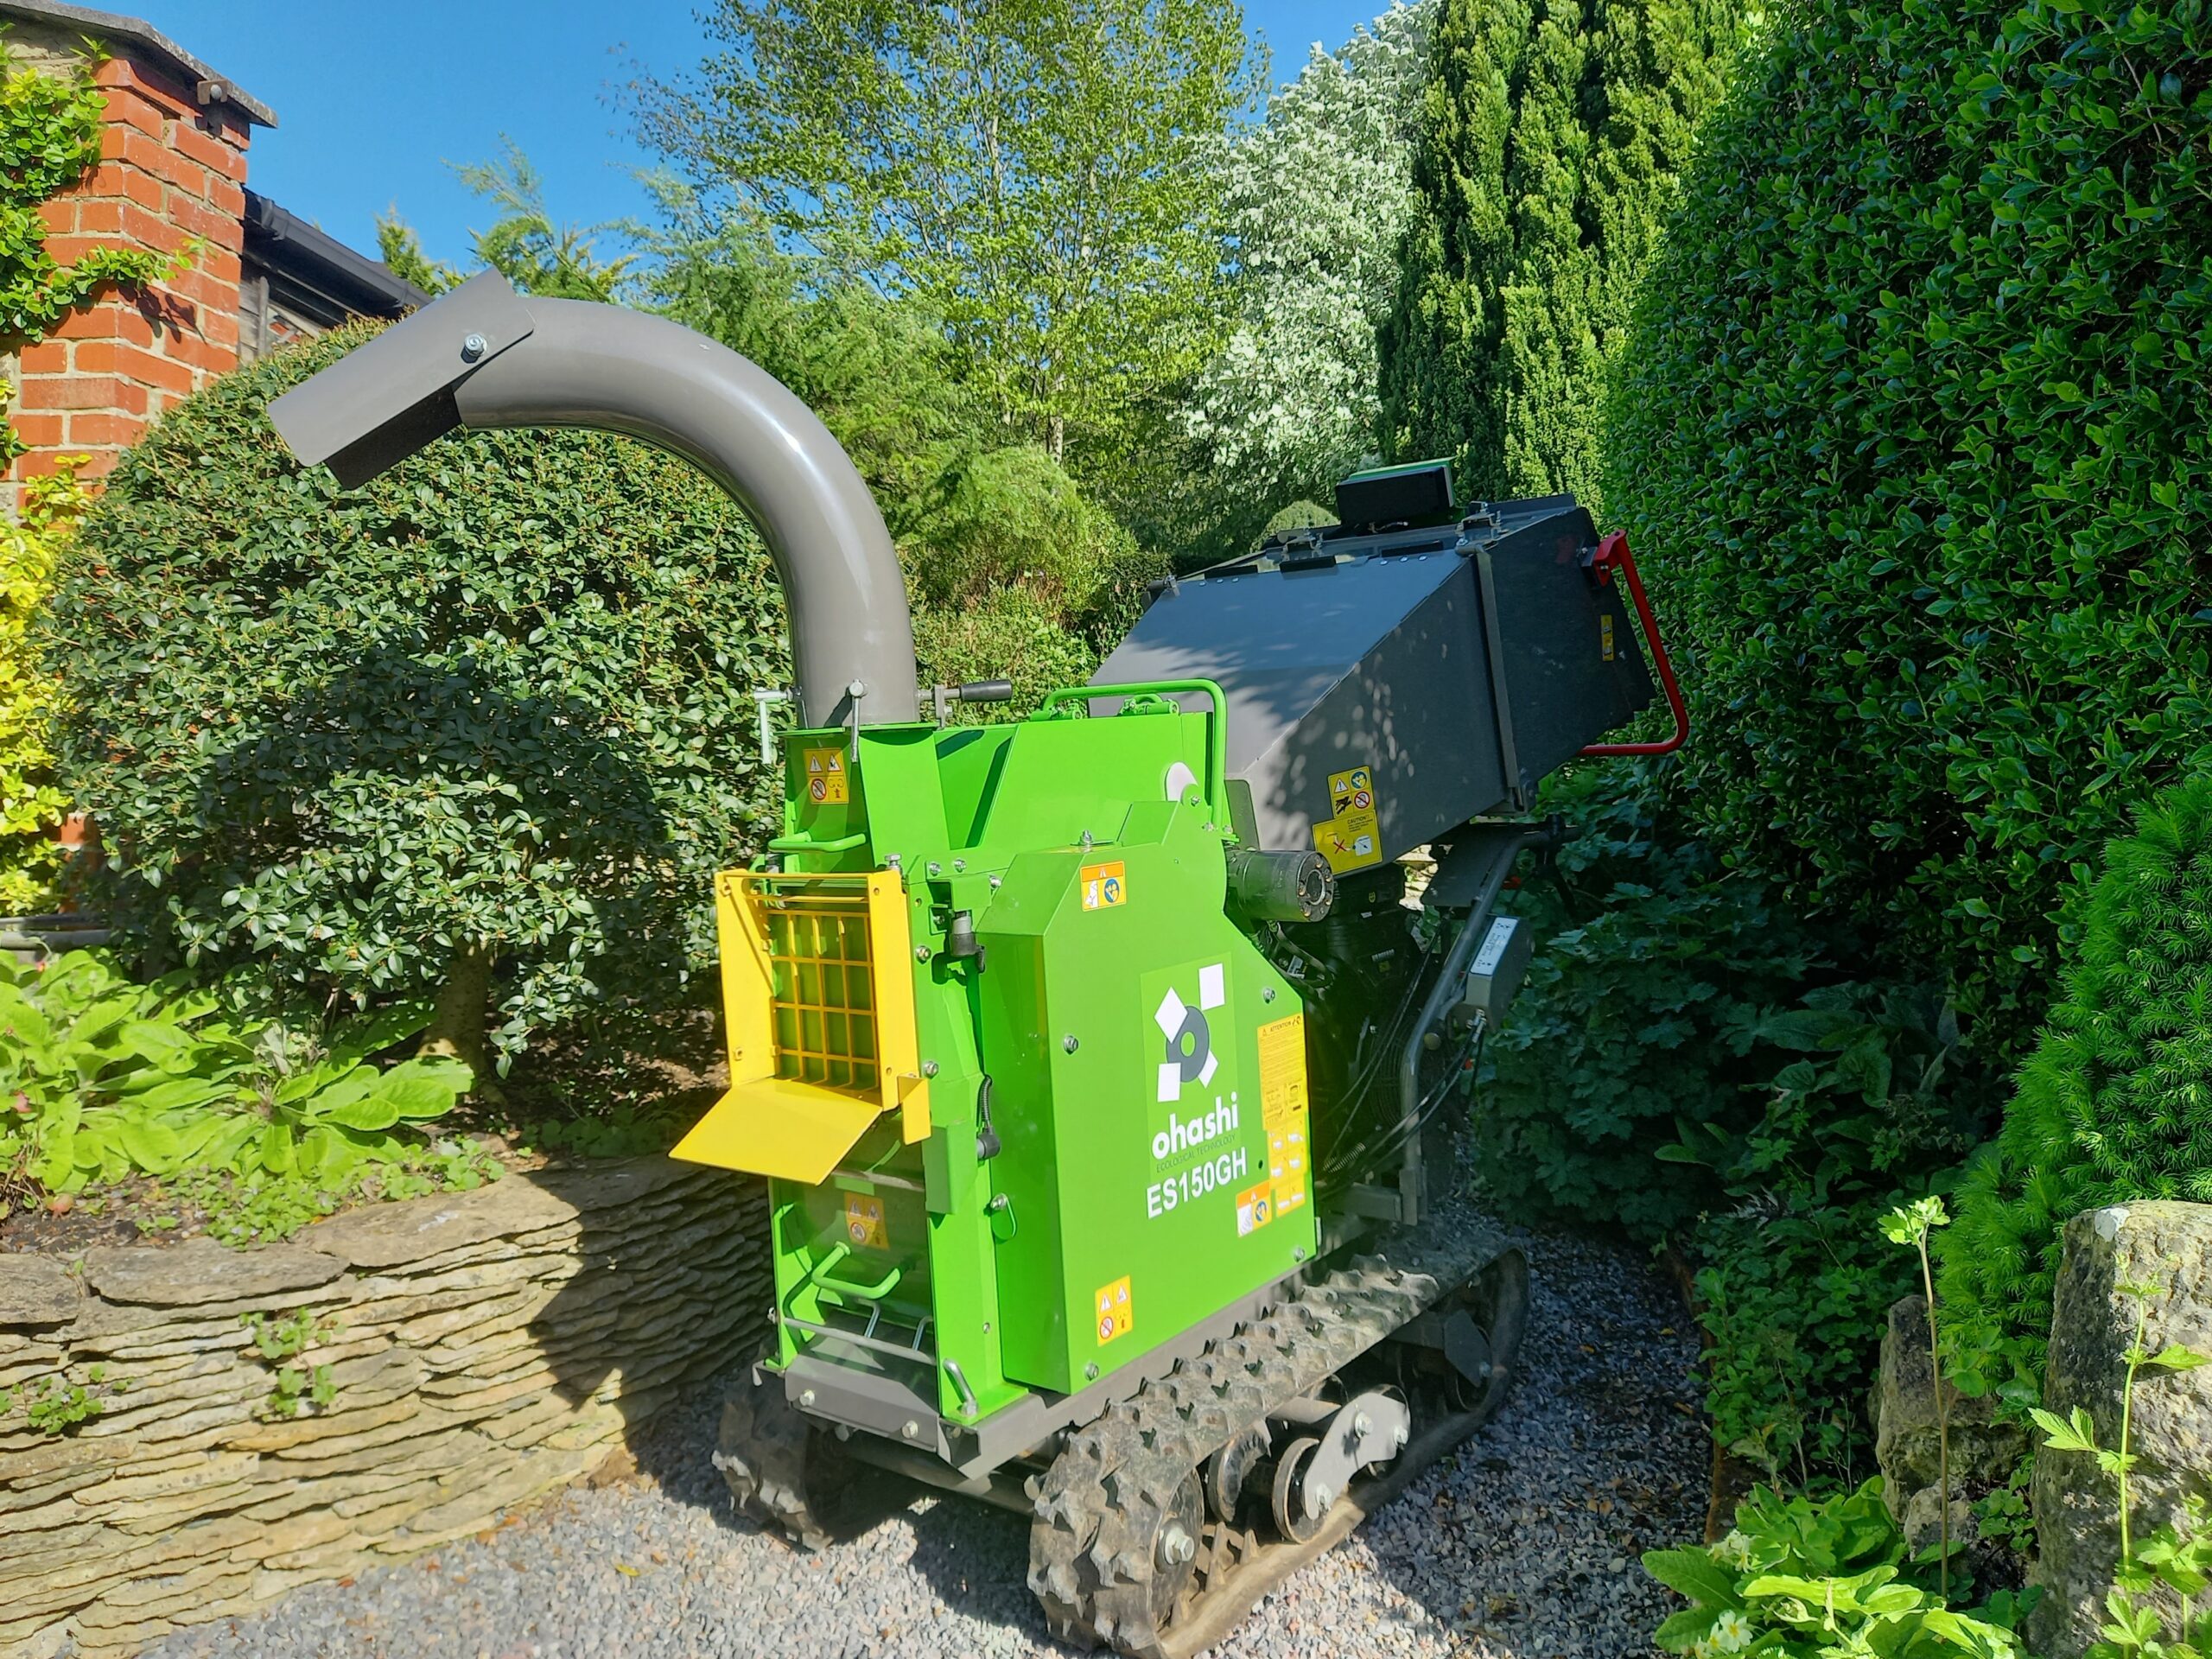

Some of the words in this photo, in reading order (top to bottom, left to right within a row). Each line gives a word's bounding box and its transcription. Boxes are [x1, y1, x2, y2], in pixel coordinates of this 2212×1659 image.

[1152, 1091, 1238, 1160] ohashi
[1156, 1152, 1195, 1173] ECOLOGICAL
[1197, 1134, 1236, 1155] TECHNOLOGY
[1147, 1147, 1247, 1219] ES150GH
